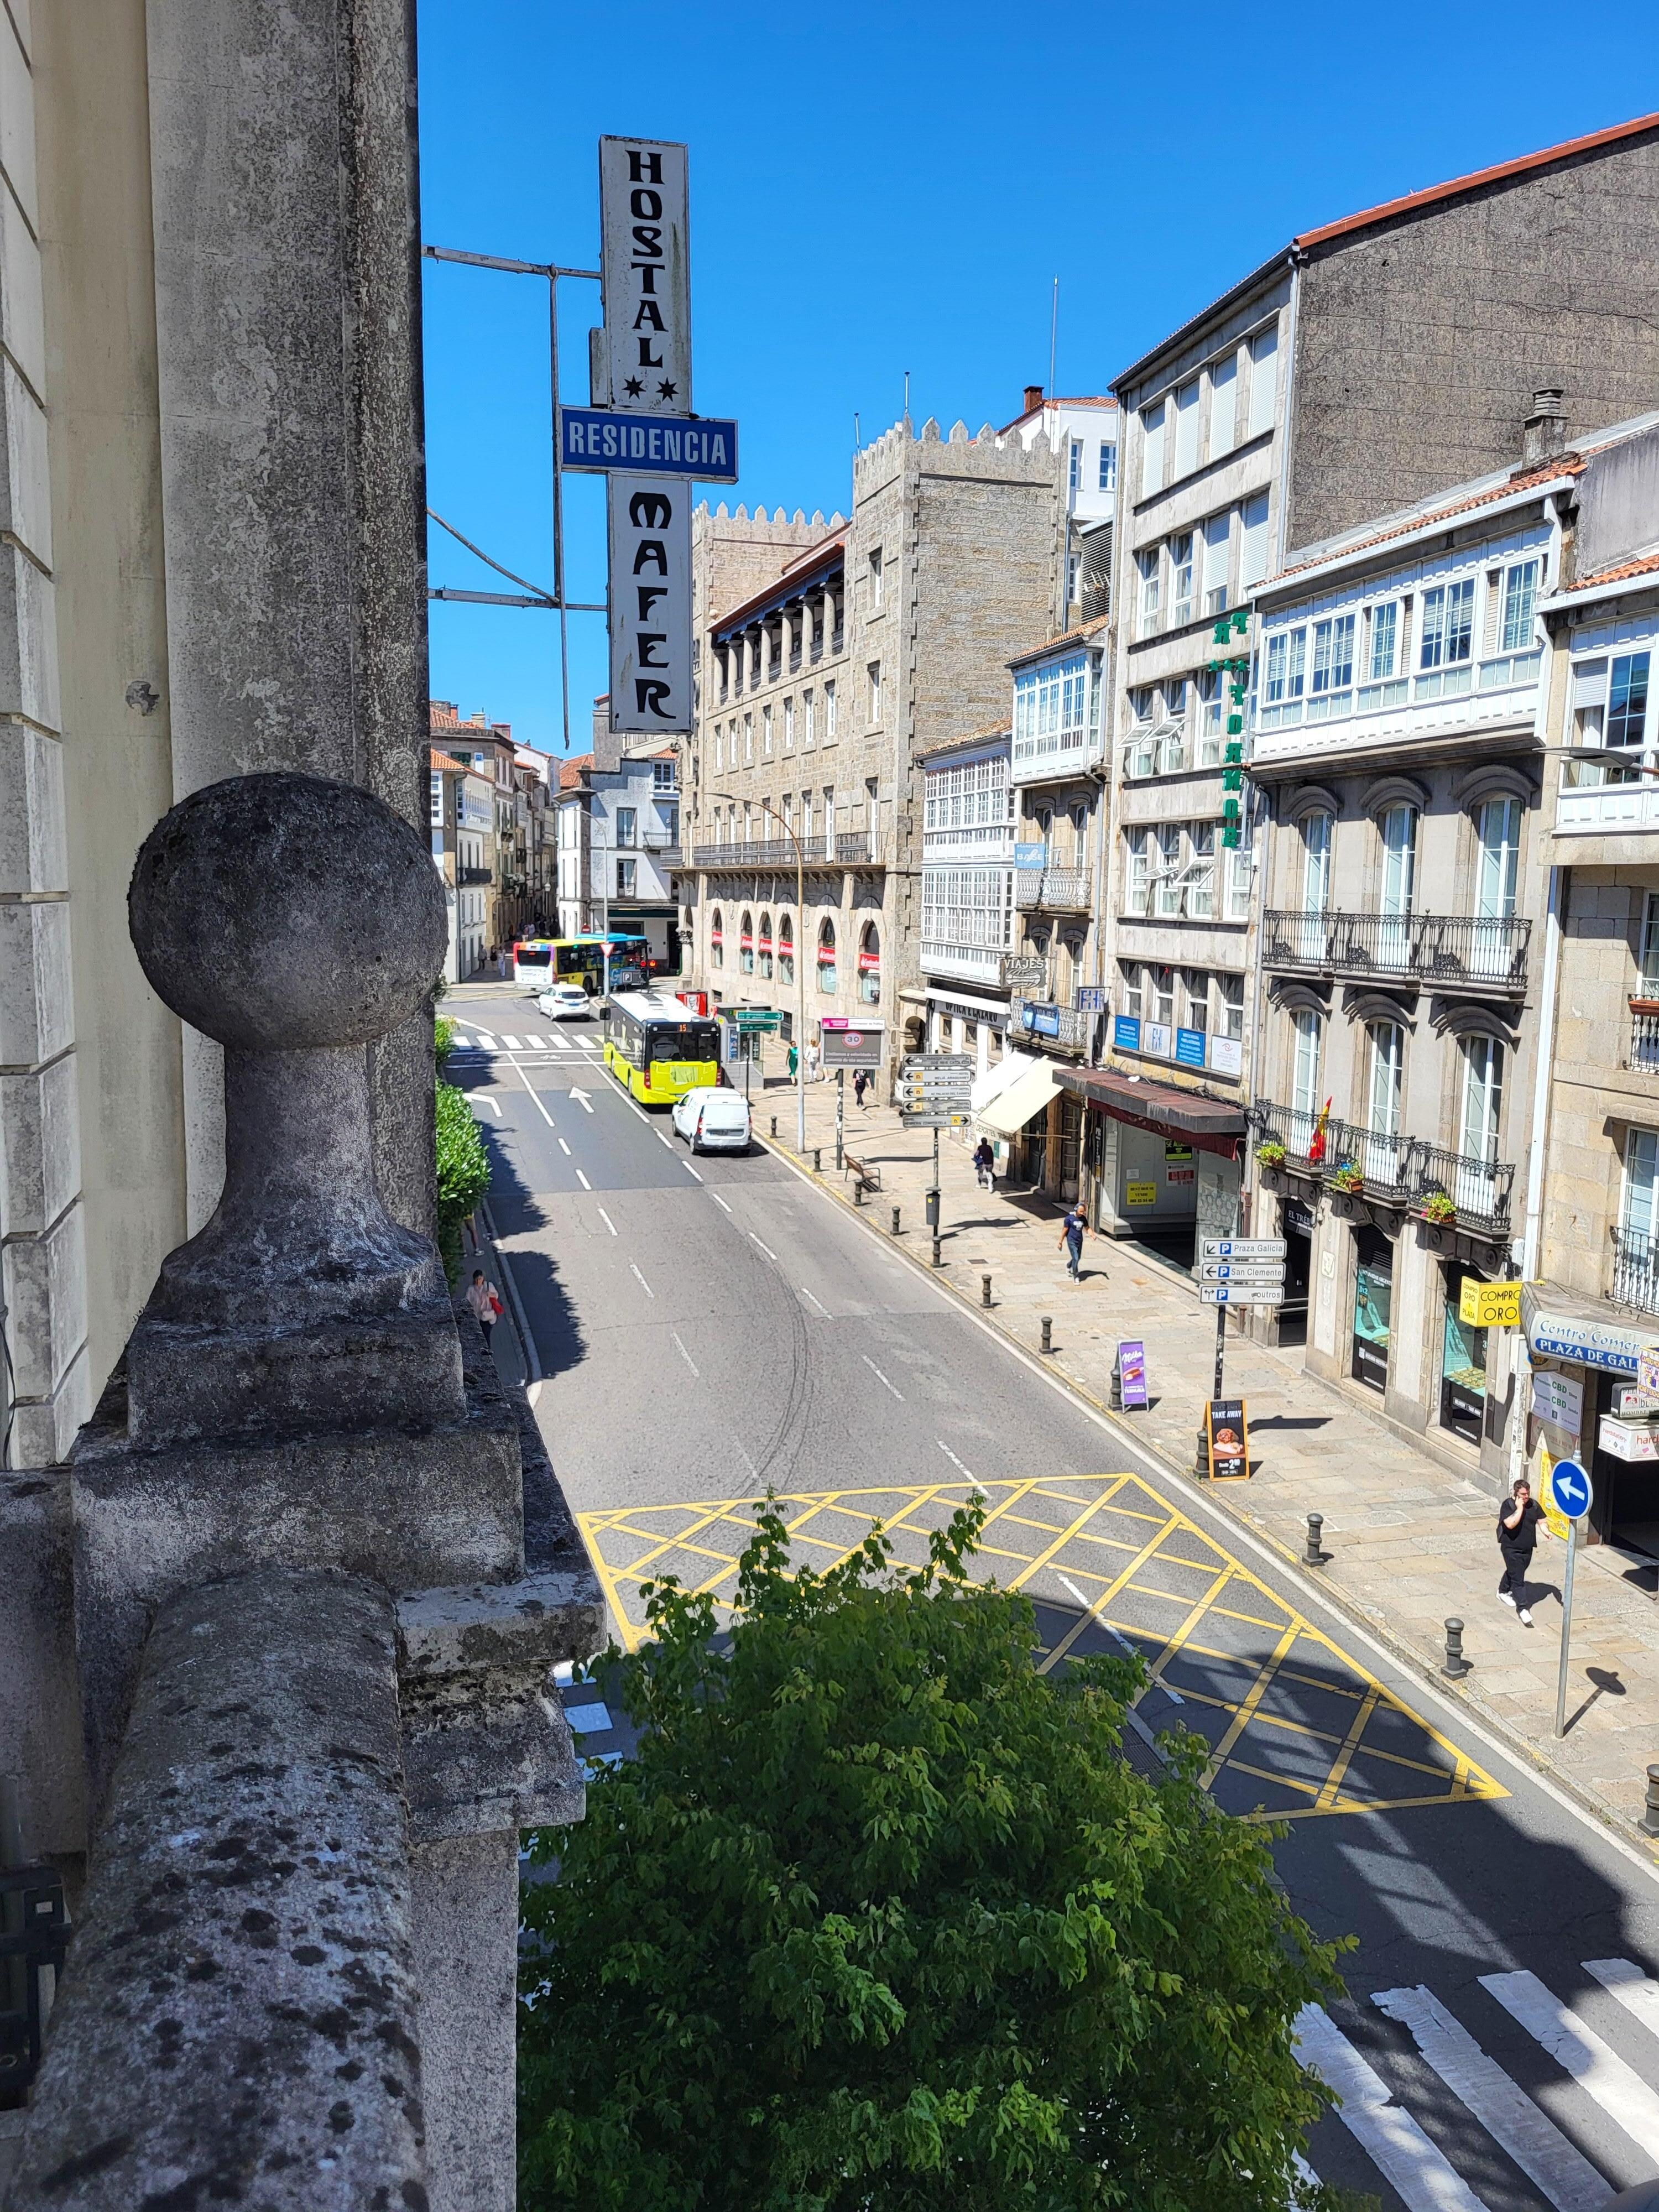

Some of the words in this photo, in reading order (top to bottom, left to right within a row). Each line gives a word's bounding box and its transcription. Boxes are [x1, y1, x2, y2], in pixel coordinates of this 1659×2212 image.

[625, 149, 669, 368] HOSTAL
[568, 421, 727, 466] RESIDENCIA
[629, 492, 676, 719] MAFER
[1017, 853, 1044, 861] BASE
[1004, 959, 1044, 969] VIAJES
[679, 1024, 687, 1032] 15
[1288, 1210, 1295, 1219] EL
[1247, 1268, 1281, 1276] Clemente
[1463, 1283, 1478, 1293] COMPRO
[1464, 1291, 1475, 1302] ORO
[1462, 1308, 1475, 1320] PLATA
[1484, 1306, 1517, 1321] ORO
[1540, 1320, 1586, 1340] Centro
[1121, 1349, 1142, 1365] Milka
[1540, 1339, 1584, 1359] PLAZA
[1588, 1349, 1604, 1363] DE
[1552, 1381, 1567, 1394] CBD
[1551, 1396, 1567, 1408] CBD
[1212, 1411, 1226, 1420] TAKE
[1227, 1410, 1242, 1418] AWAY
